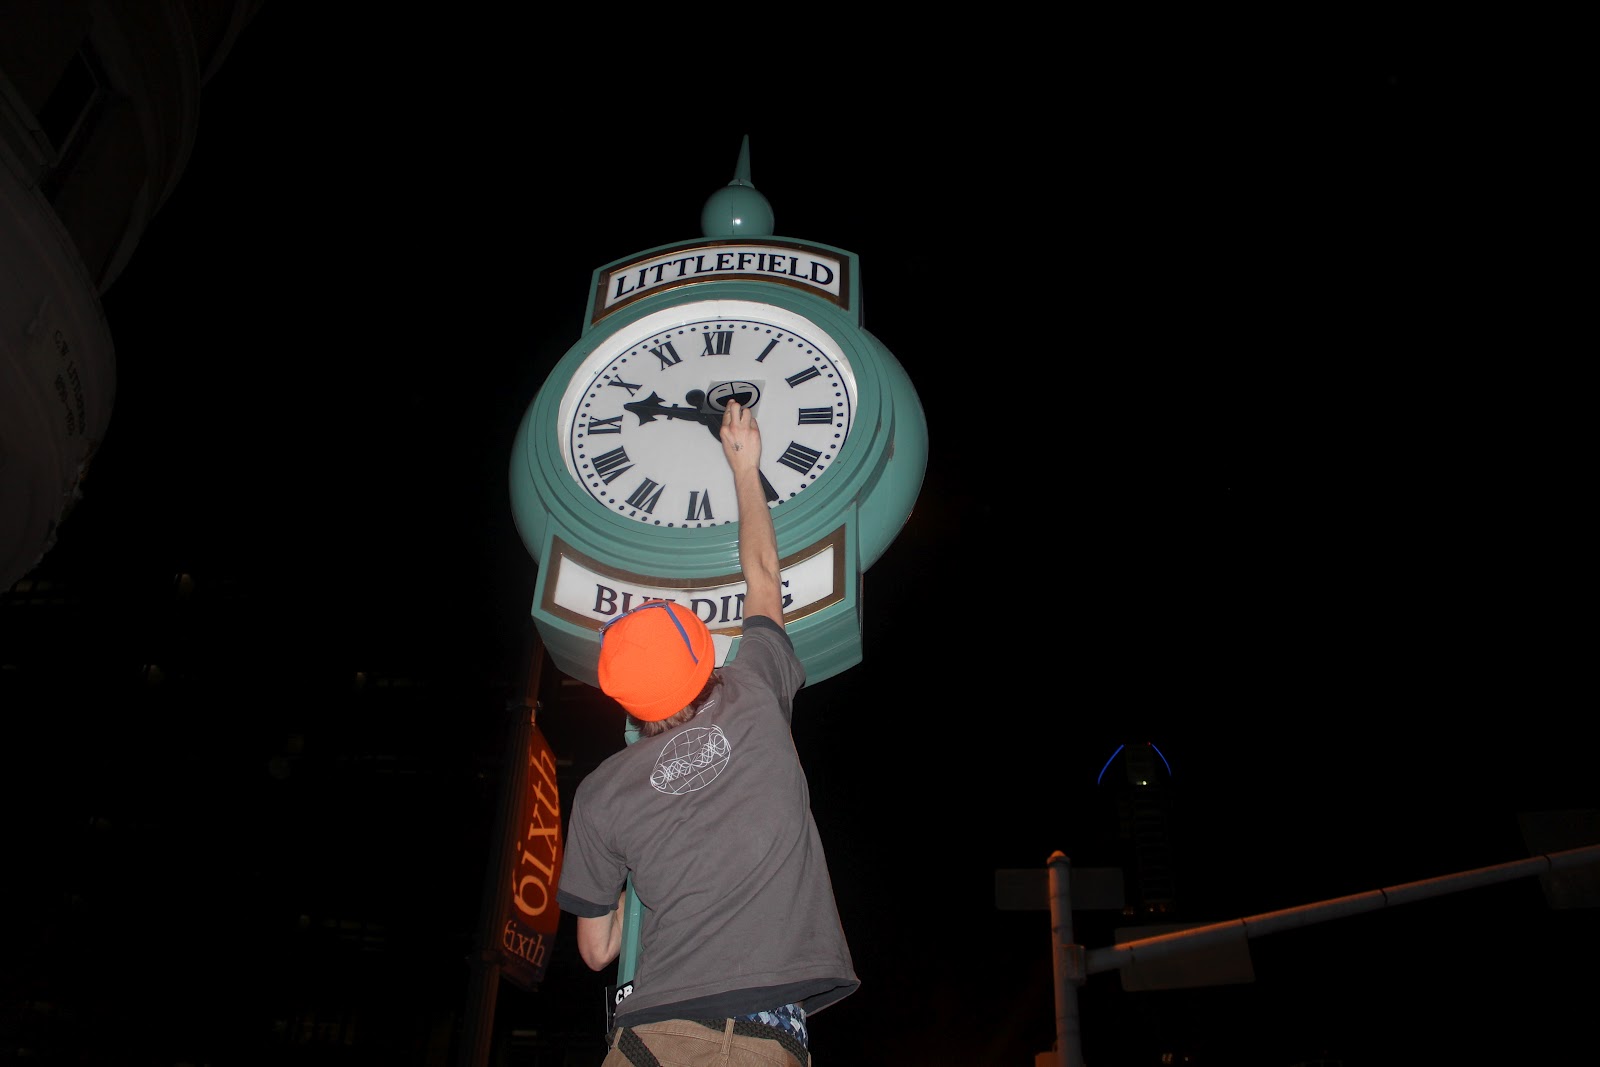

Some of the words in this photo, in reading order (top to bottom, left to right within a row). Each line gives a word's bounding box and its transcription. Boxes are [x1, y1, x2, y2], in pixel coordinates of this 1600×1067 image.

[614, 252, 834, 299] LITTLEFIELD
[649, 341, 683, 371] XI
[701, 331, 734, 357] XII
[755, 338, 780, 363] I
[607, 374, 643, 397] X
[785, 365, 821, 388] II
[587, 415, 624, 435] IX
[797, 406, 833, 425] III
[590, 445, 635, 486] VIII
[624, 477, 666, 514] VII
[685, 488, 714, 521] VI
